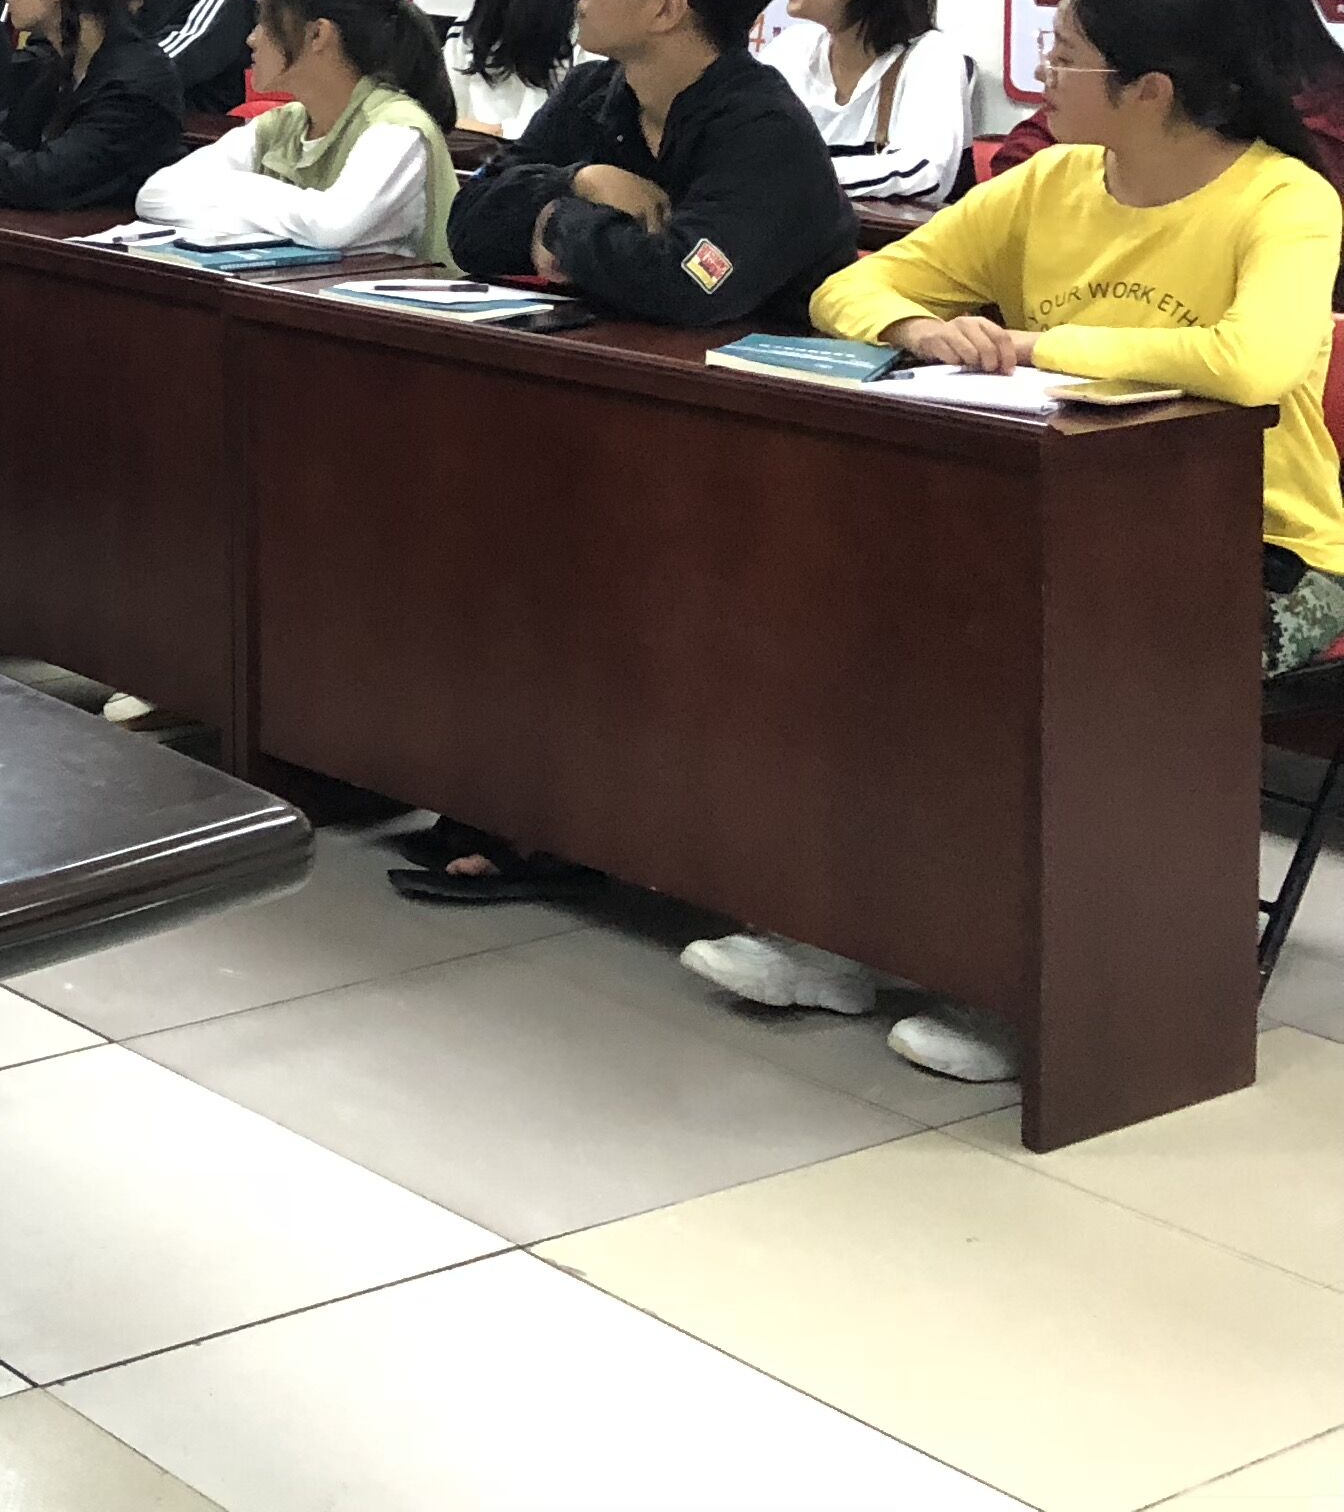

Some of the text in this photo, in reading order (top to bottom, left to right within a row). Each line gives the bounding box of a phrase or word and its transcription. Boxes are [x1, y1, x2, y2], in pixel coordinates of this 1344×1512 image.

[1026, 281, 1207, 328] YOUR WORK ETH
